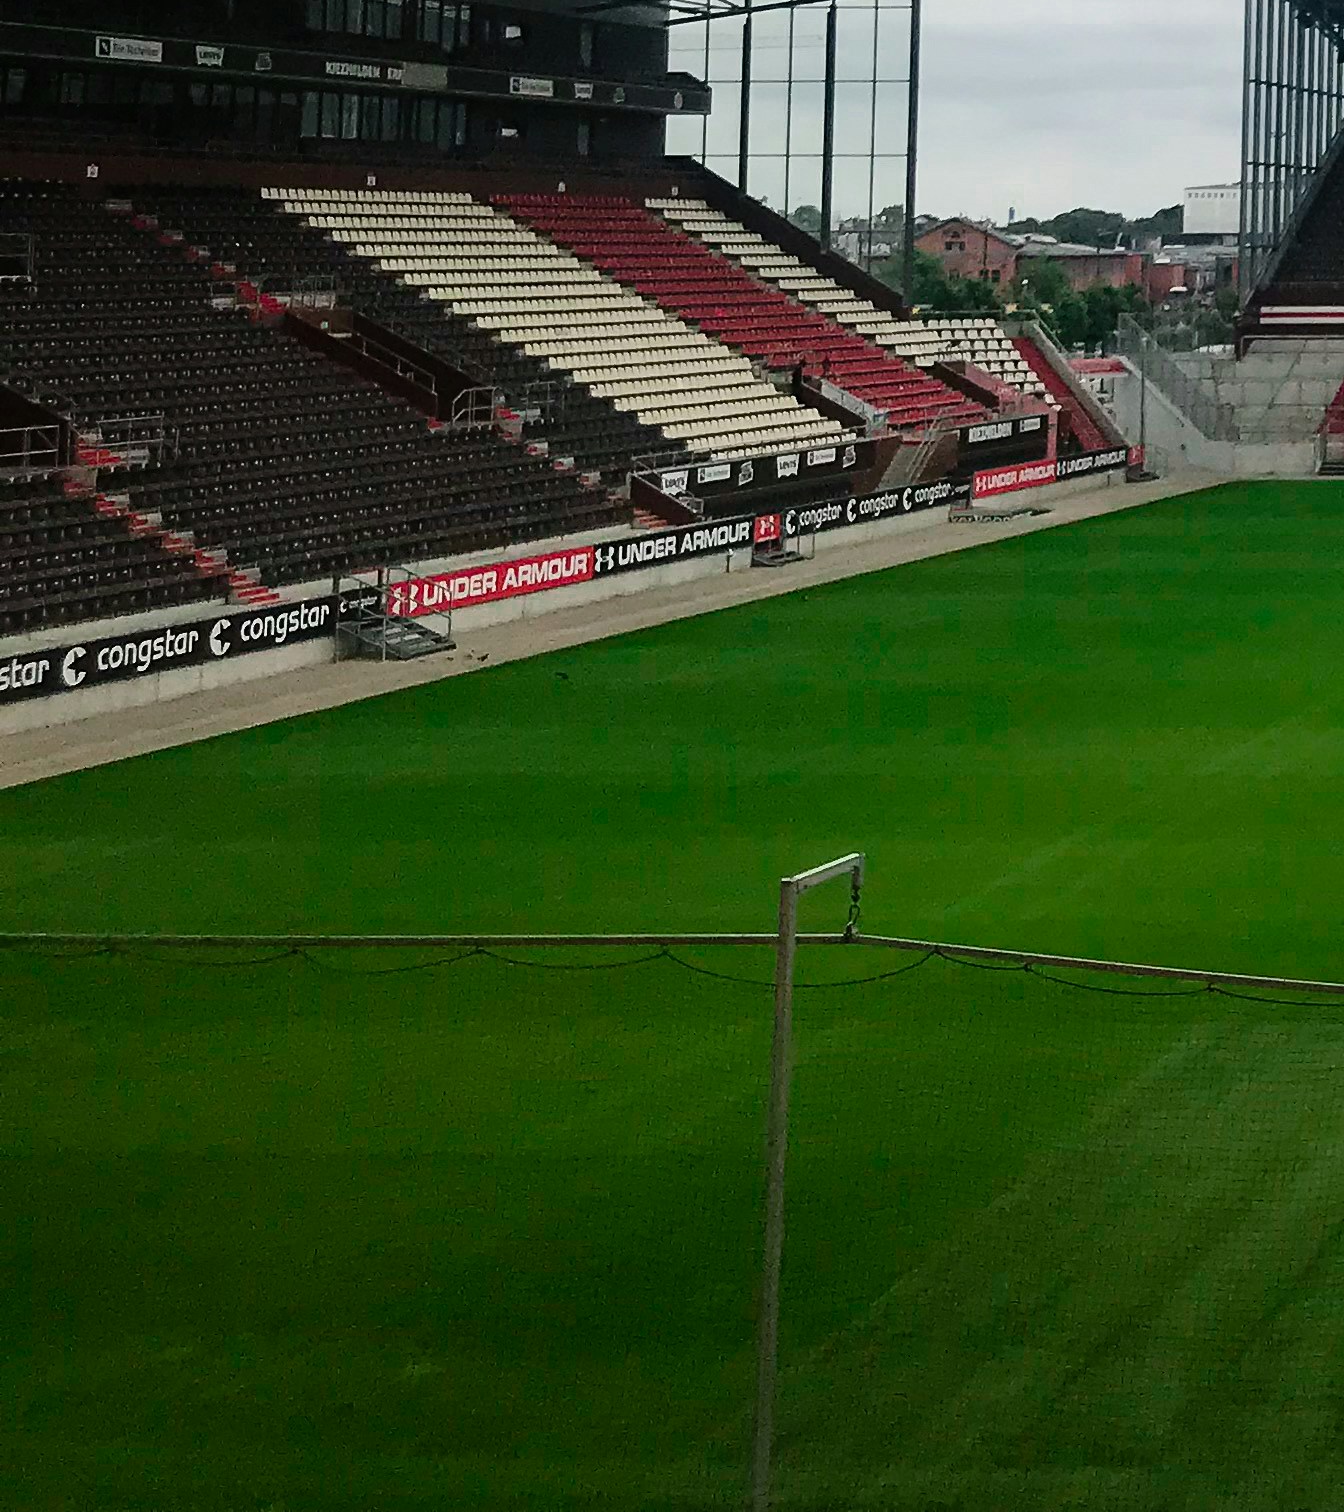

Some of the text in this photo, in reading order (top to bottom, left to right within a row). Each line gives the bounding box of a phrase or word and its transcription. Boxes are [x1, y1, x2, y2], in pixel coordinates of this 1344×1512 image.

[800, 503, 842, 527] congstar
[859, 492, 899, 516] congstar
[914, 482, 951, 506] congstar
[619, 521, 750, 566] UNDER ARMOUR
[423, 567, 497, 607] UNDER
[502, 552, 588, 590] ARMOUR
[97, 628, 199, 672] congstar
[240, 601, 330, 643] congstar
